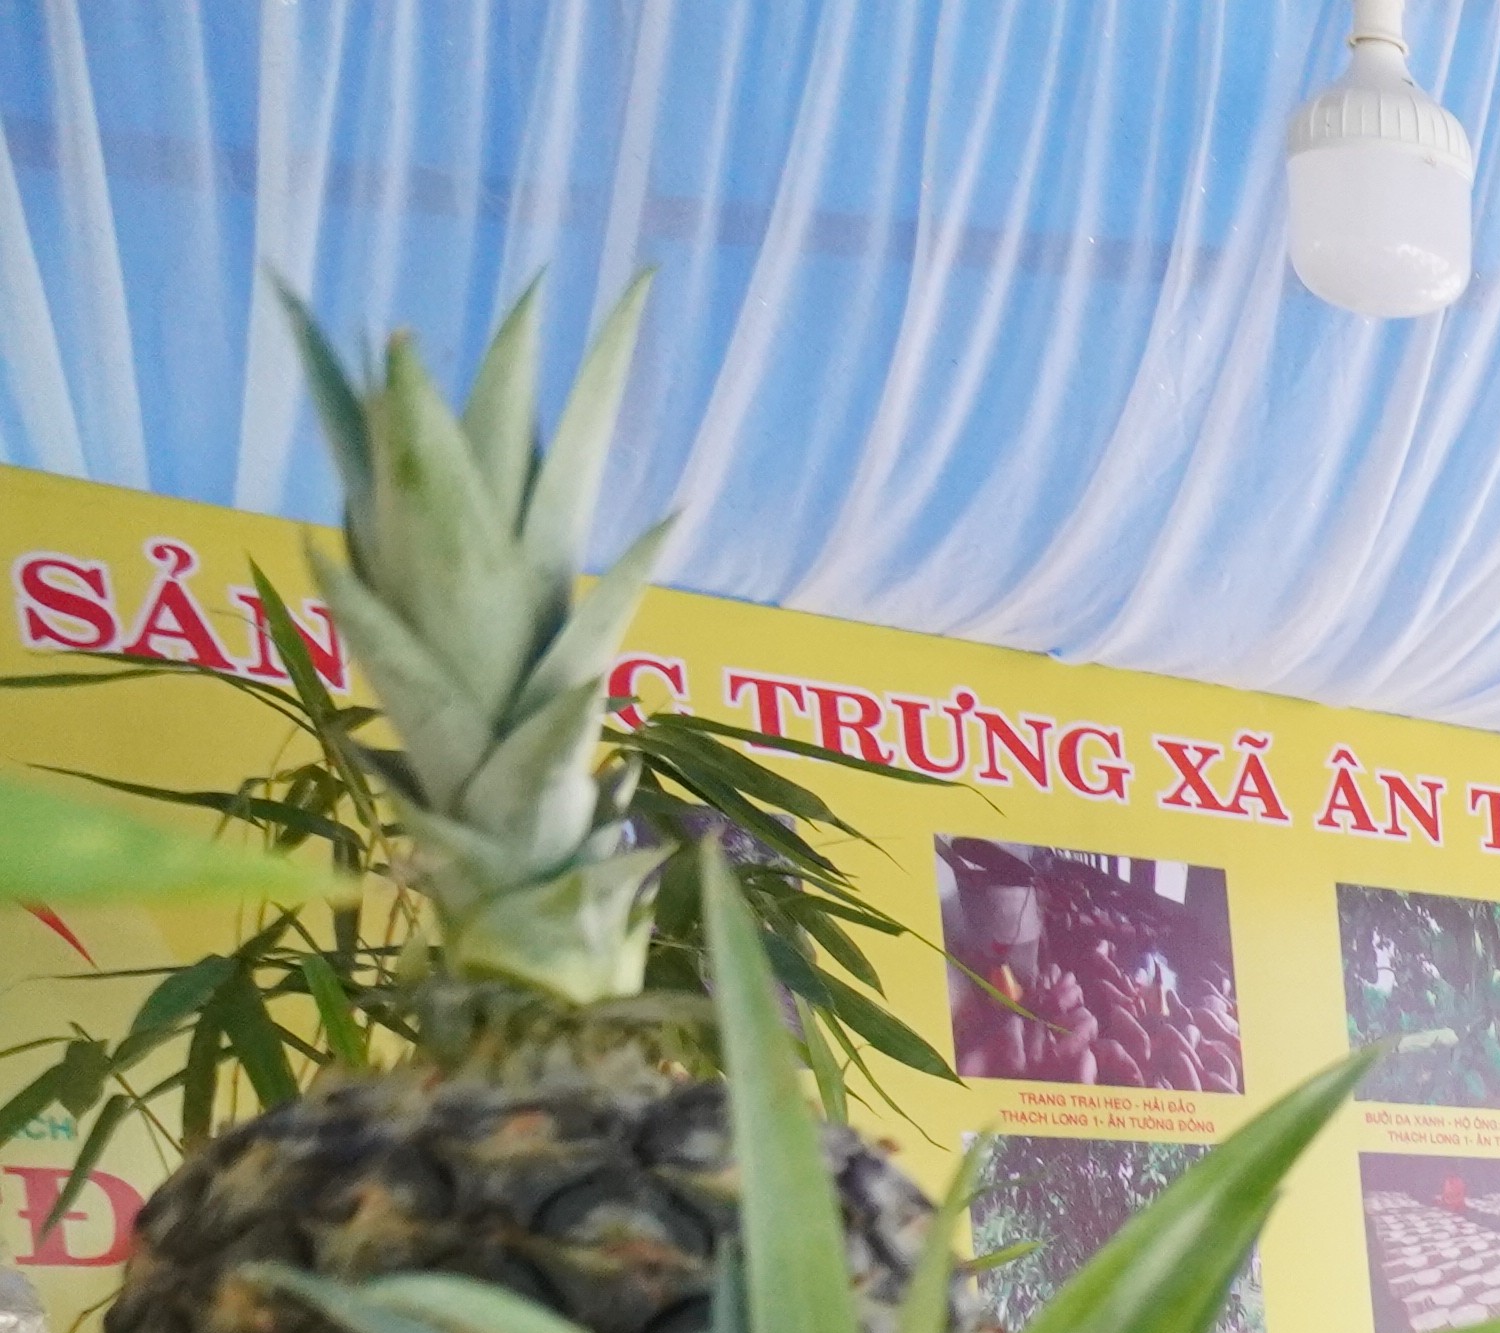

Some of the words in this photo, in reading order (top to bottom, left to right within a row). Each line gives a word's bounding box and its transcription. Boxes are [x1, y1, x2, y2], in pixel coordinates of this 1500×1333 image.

[728, 673, 1131, 800] TRƯNG
[1156, 734, 1289, 821] XÃ
[1316, 749, 1444, 842] ÂN
[1018, 1091, 1067, 1107] TRANG
[1070, 1094, 1101, 1110] TRẠI
[1103, 1096, 1133, 1111] HEO
[1000, 1109, 1048, 1126] THẠCH
[1051, 1112, 1088, 1127] LONG
[1107, 1112, 1126, 1128] ÂN
[1128, 1115, 1174, 1131] TƯỜNG
[1395, 1114, 1411, 1126] DA
[1413, 1114, 1446, 1127] XANH
[1429, 1132, 1460, 1145] LONG
